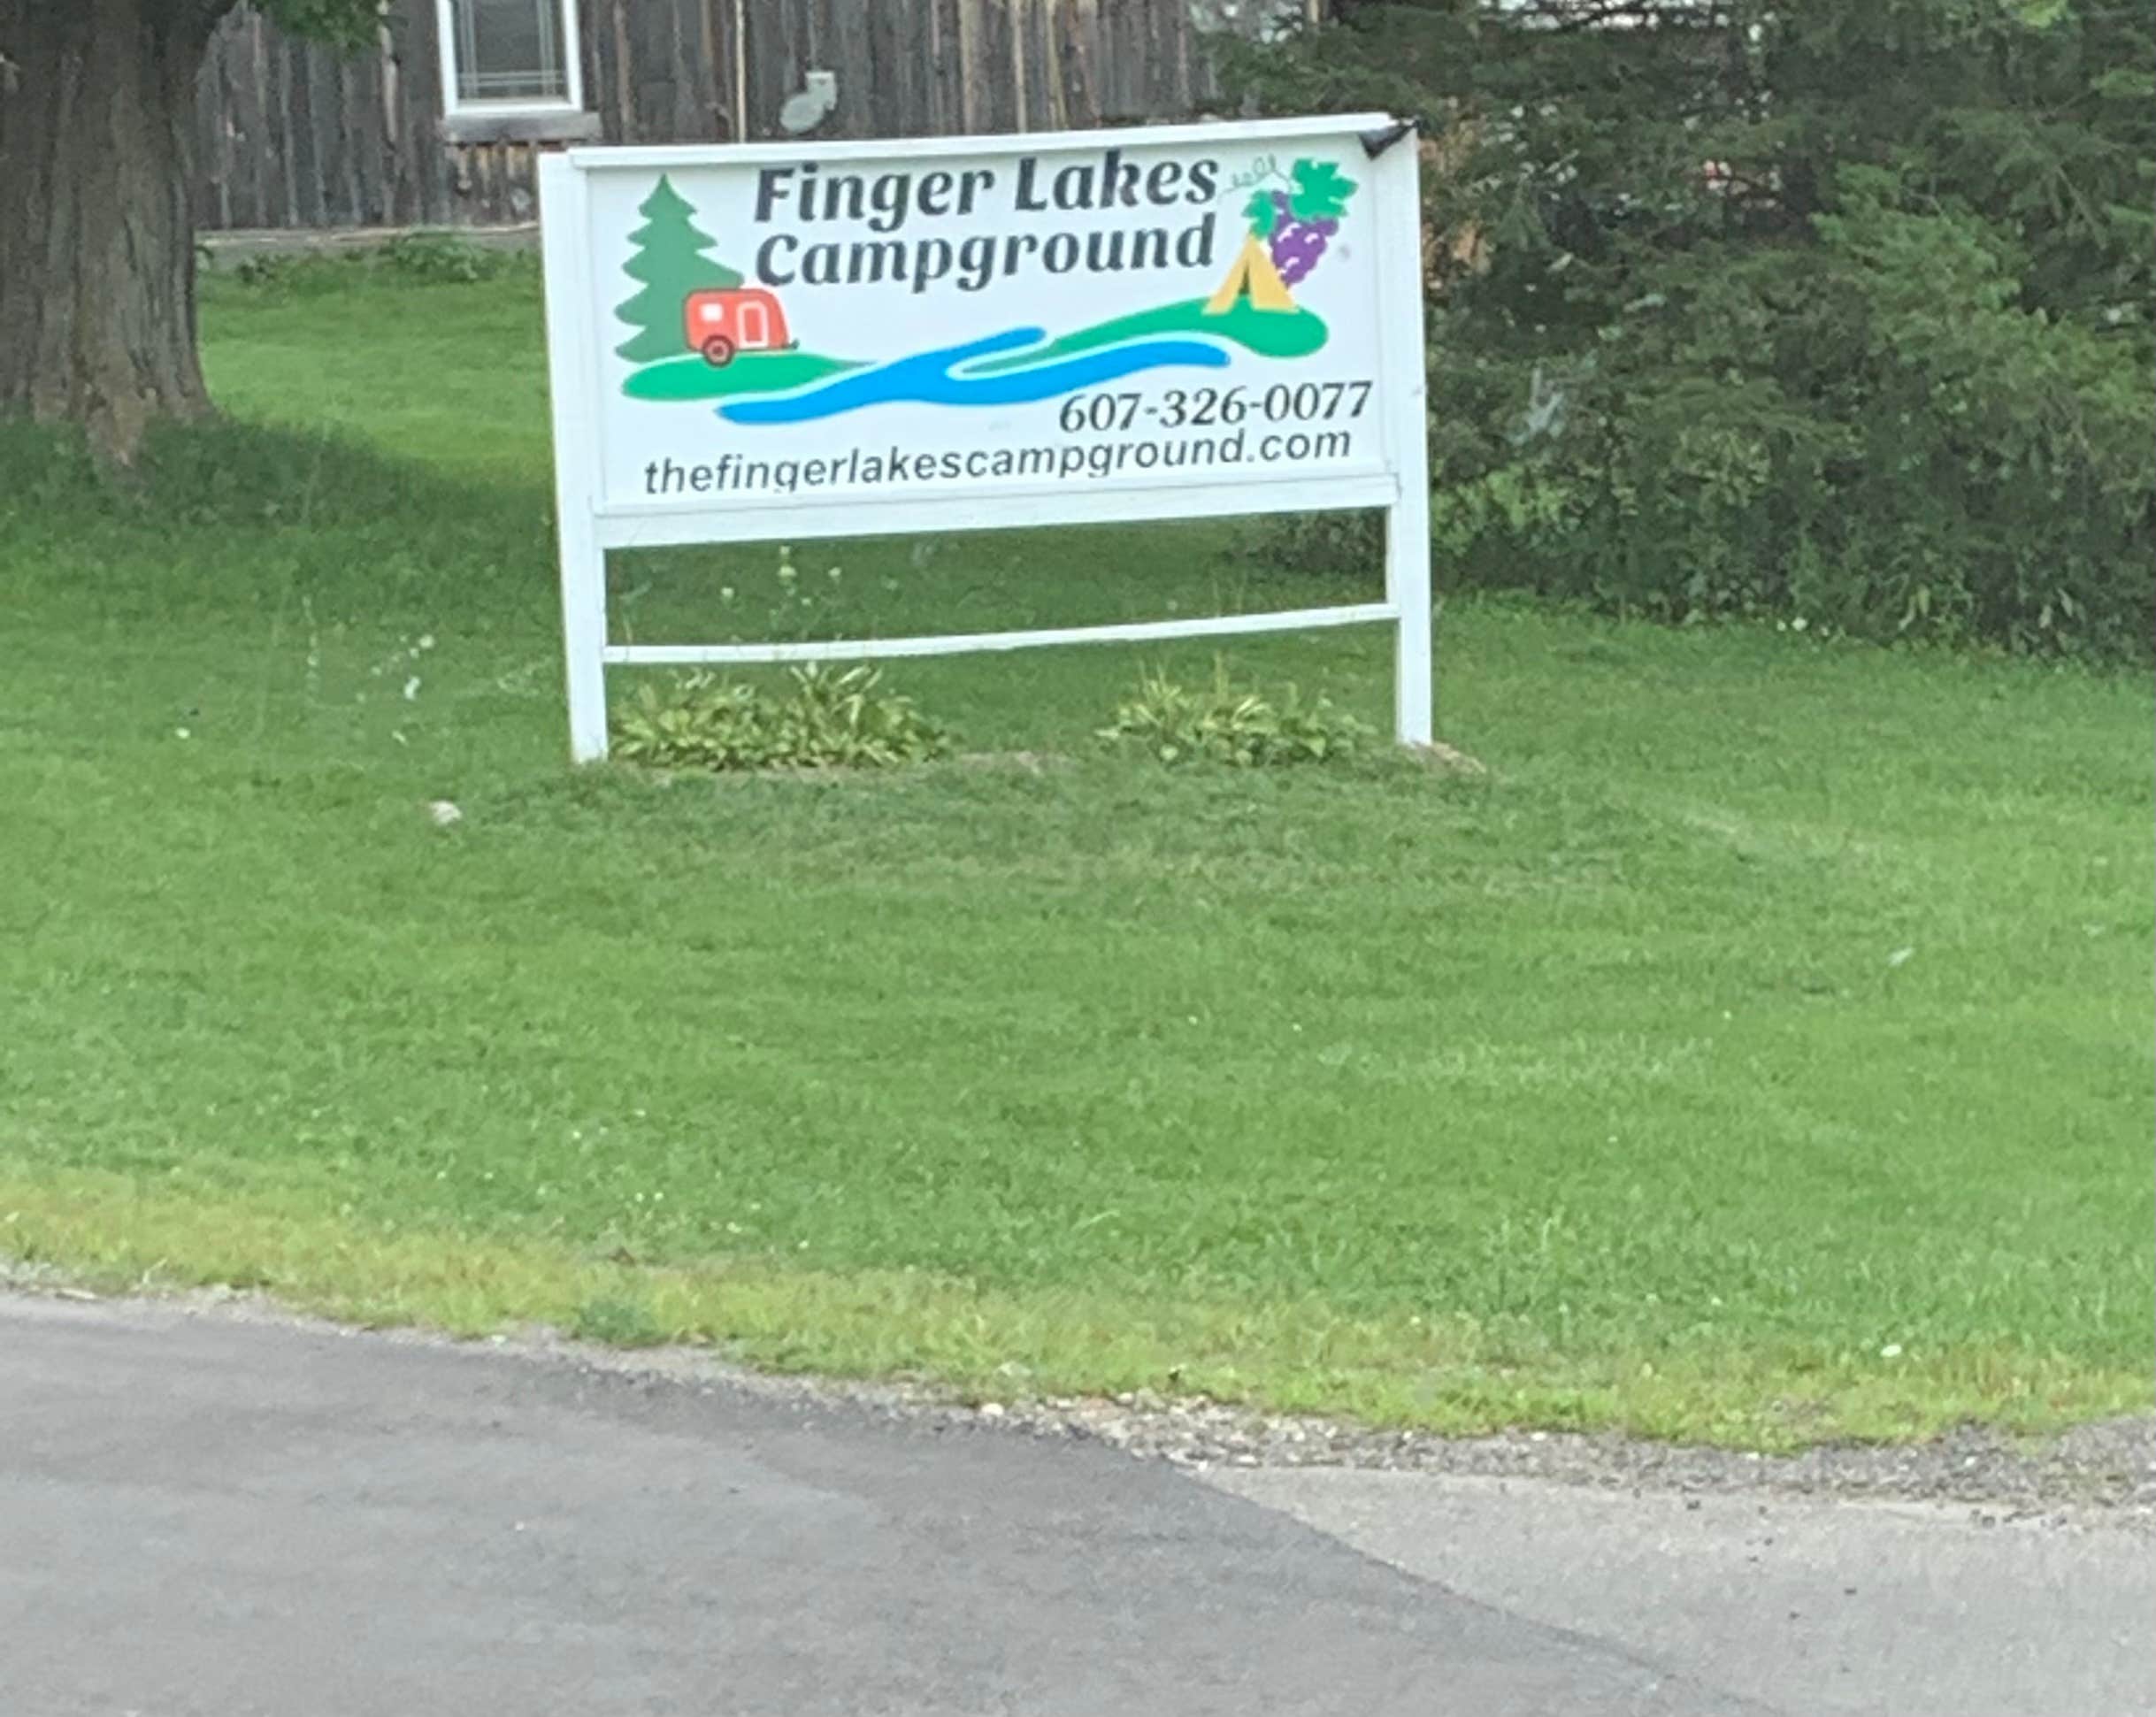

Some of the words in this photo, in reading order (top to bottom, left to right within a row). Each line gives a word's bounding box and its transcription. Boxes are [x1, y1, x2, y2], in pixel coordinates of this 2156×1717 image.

[754, 161, 995, 233] Finger
[1014, 149, 1219, 212] Lakes
[756, 211, 1216, 294] Campground
[1059, 380, 1373, 433] 607-326-0077
[644, 428, 1351, 494] thefingerlakescampground.com
